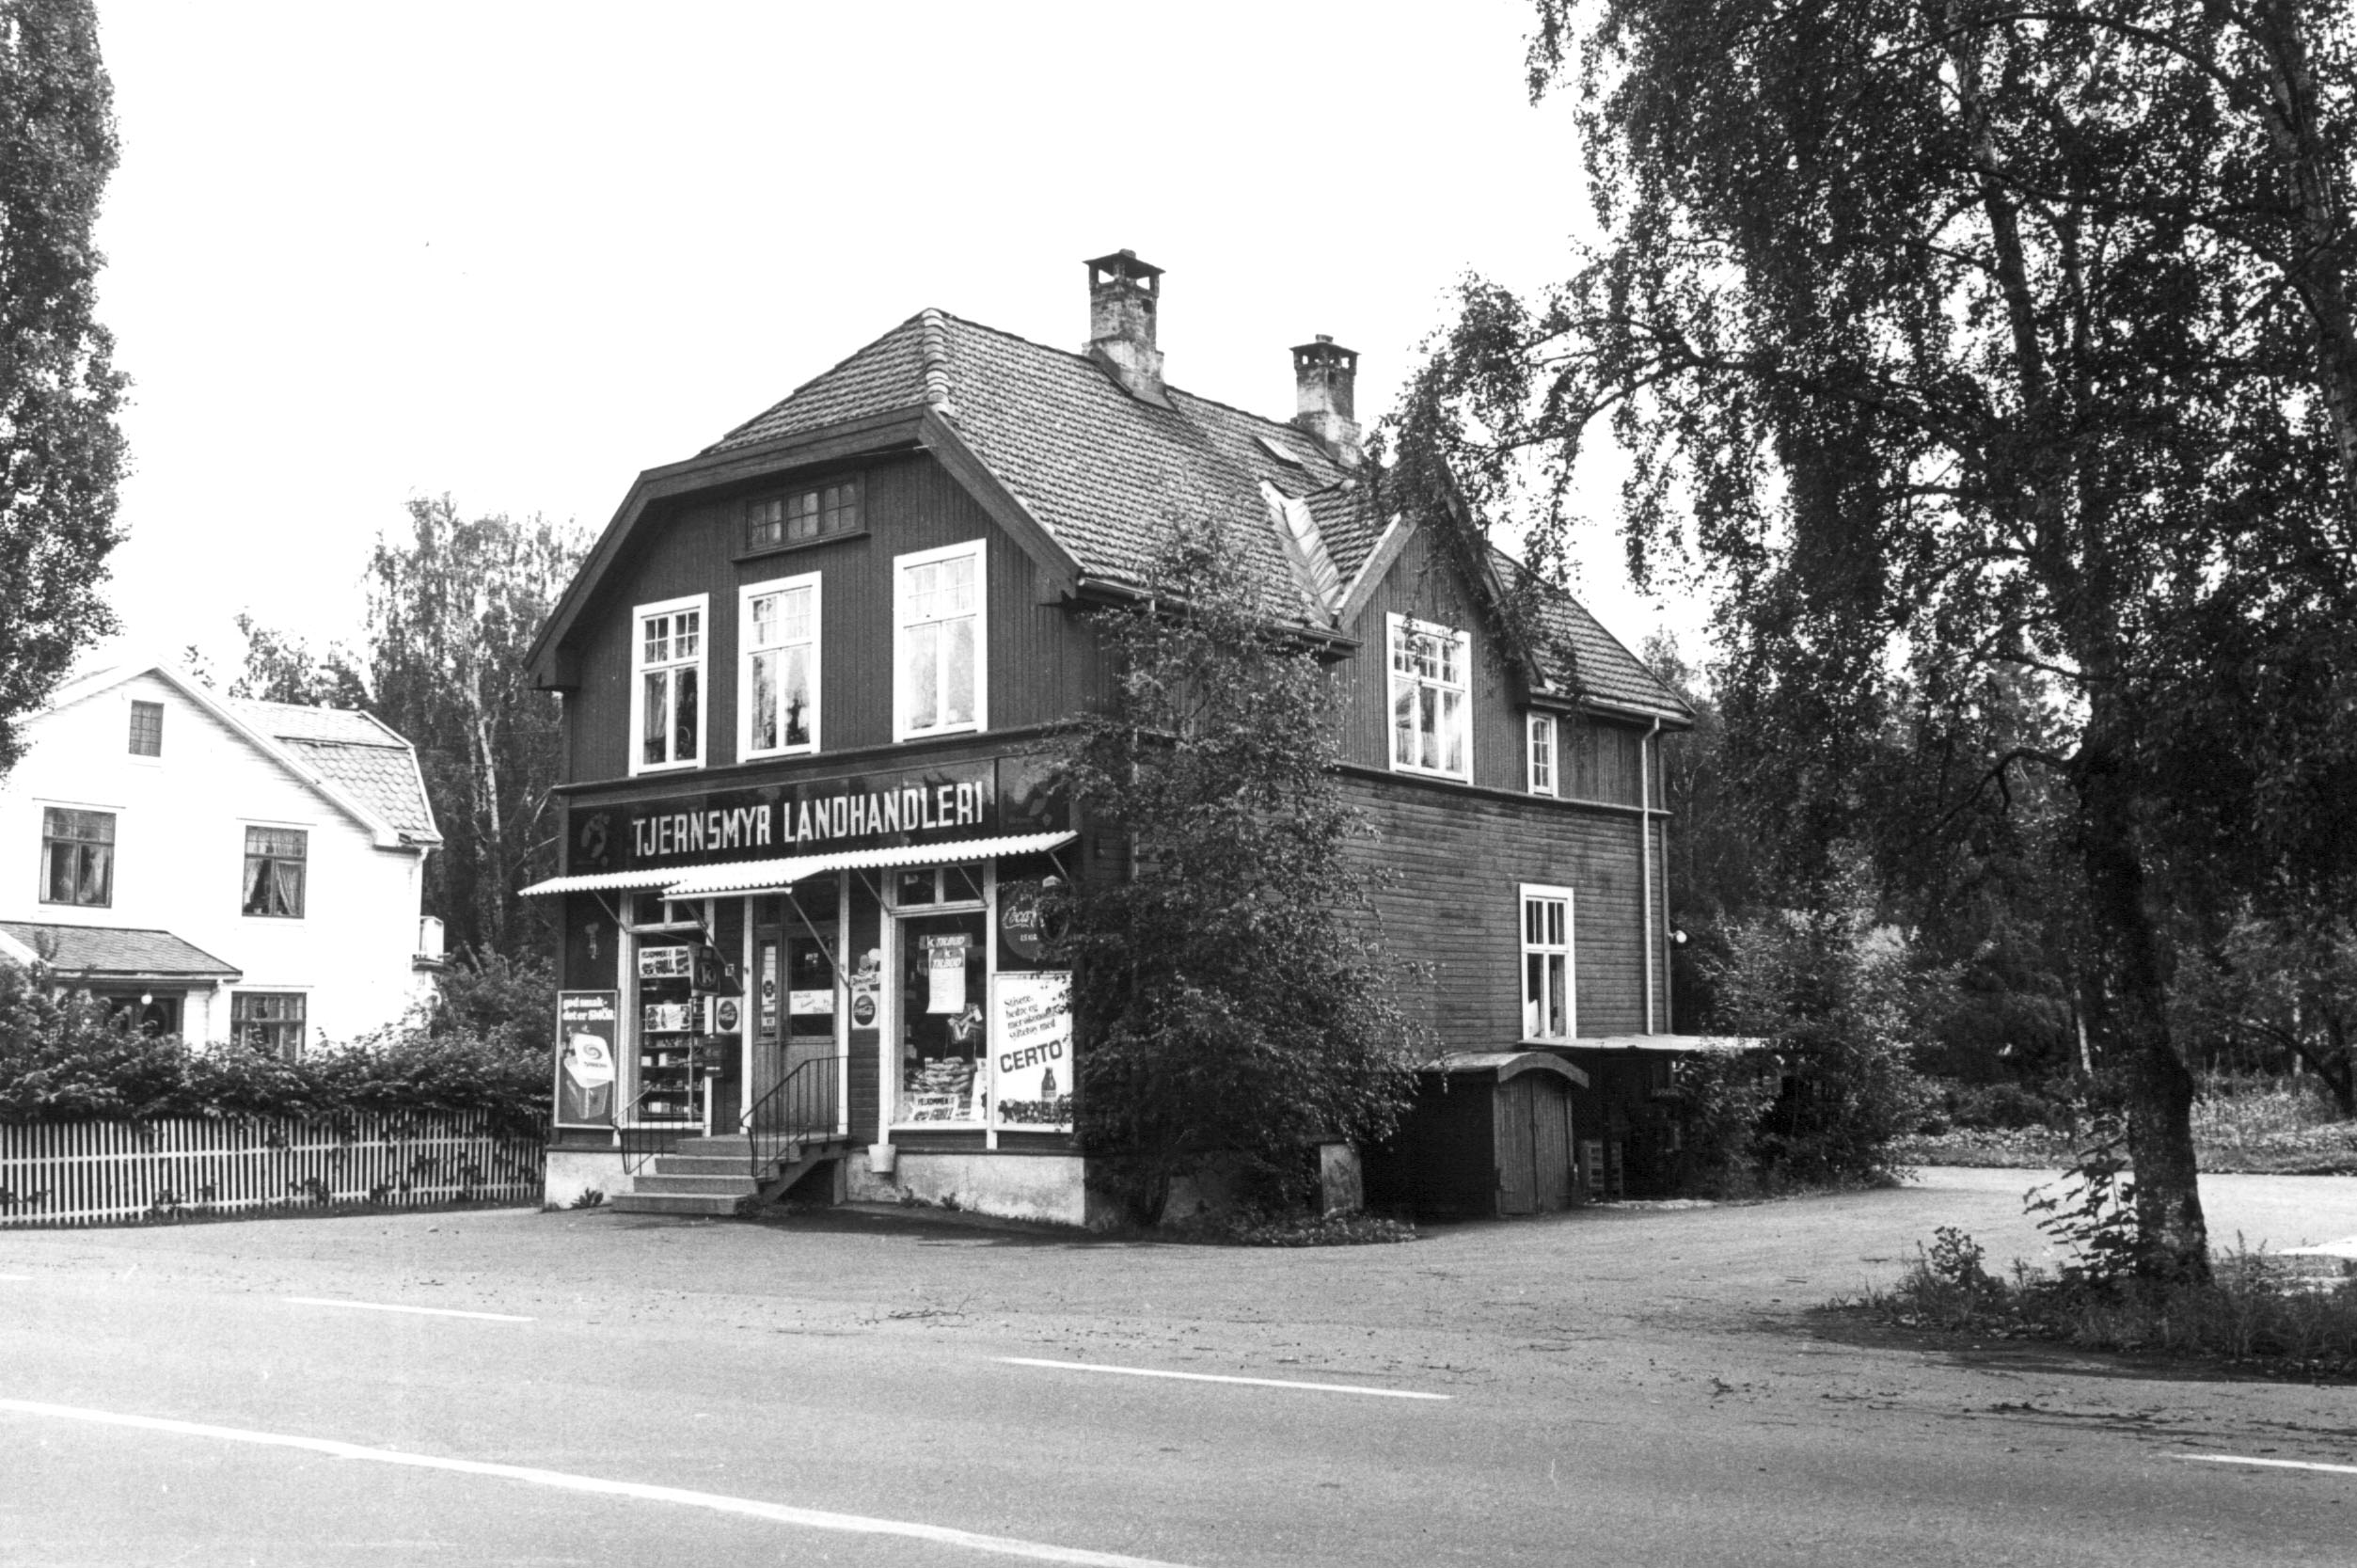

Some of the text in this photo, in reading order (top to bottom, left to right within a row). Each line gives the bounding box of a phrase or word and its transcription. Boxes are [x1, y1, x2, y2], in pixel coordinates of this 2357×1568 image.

[632, 781, 983, 857] TJERNSMYR LANDHANDLERI
[1039, 1018, 1055, 1031] med
[1000, 1039, 1063, 1074] CERTO
